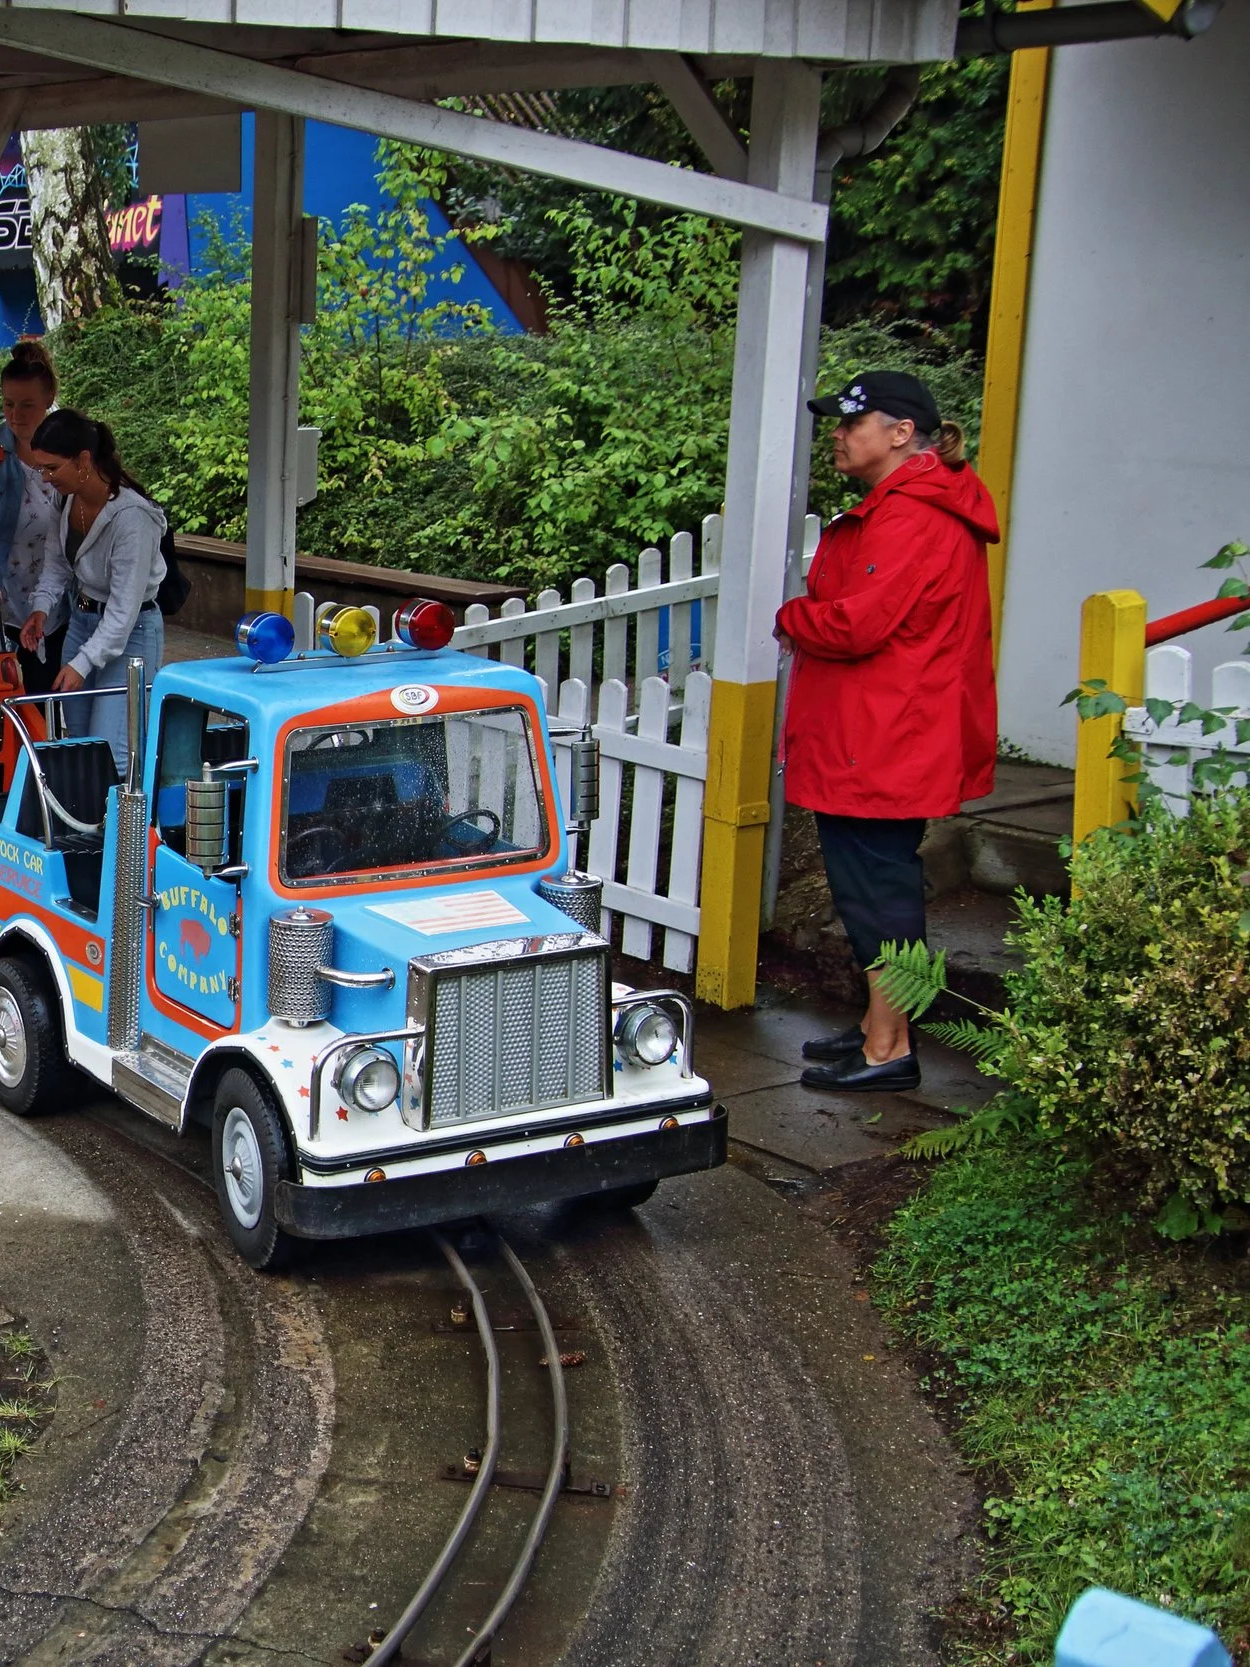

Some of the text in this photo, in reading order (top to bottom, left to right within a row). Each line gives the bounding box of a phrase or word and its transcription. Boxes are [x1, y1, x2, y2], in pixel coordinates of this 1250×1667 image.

[405, 691, 422, 701] SBF
[23, 850, 44, 876] CAR
[160, 886, 228, 936] BUFFALO
[159, 941, 227, 994] COMPANY
